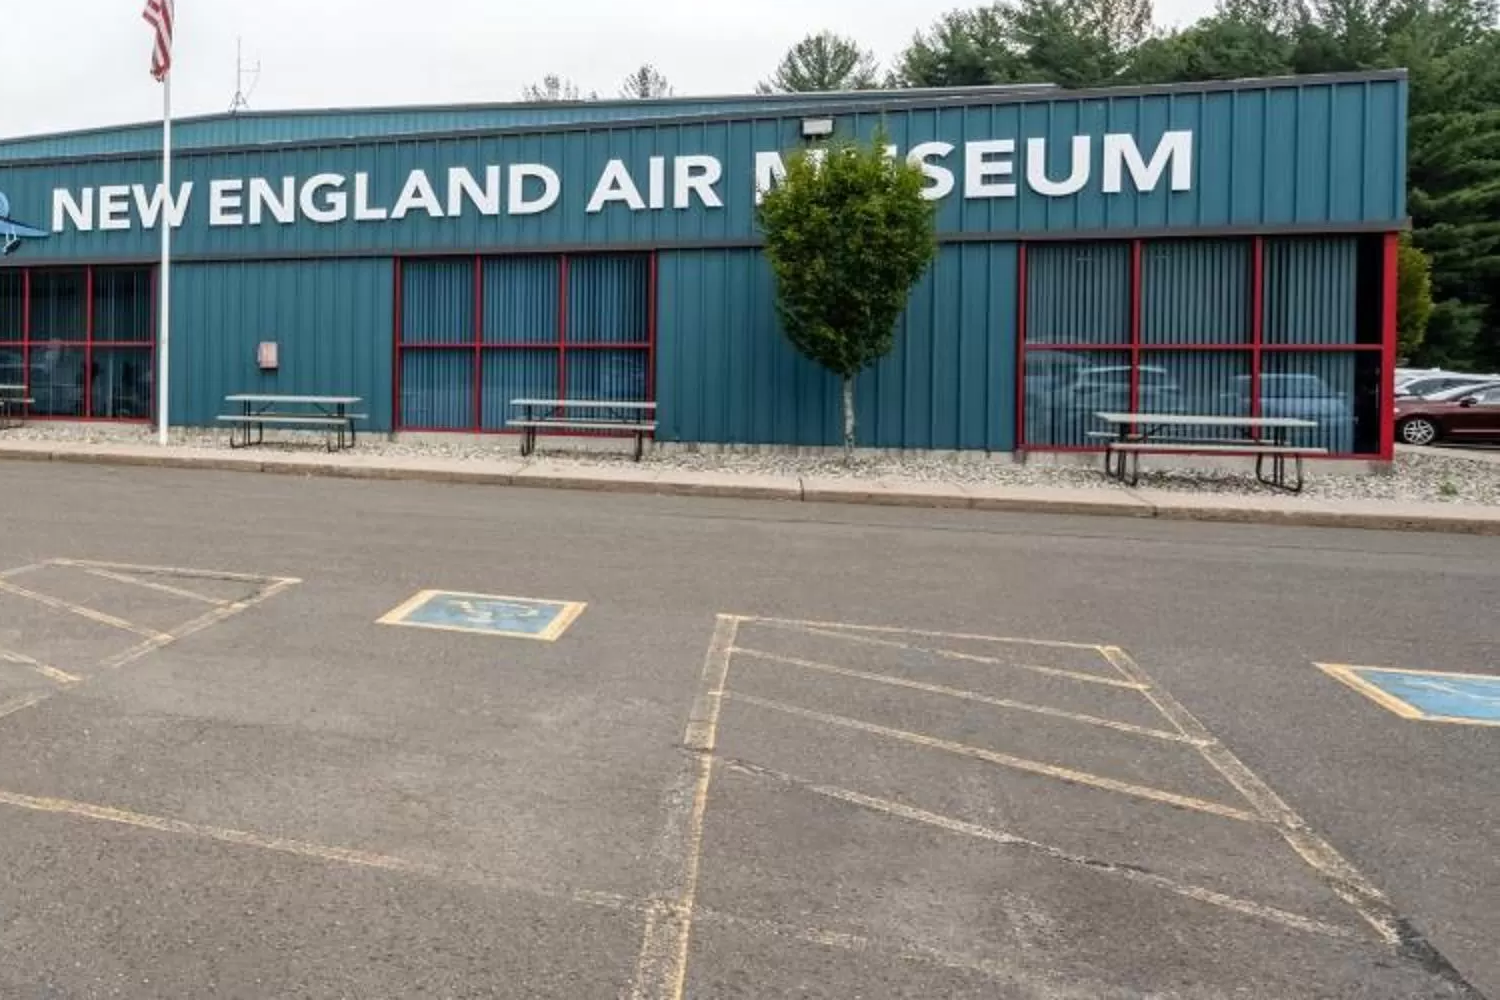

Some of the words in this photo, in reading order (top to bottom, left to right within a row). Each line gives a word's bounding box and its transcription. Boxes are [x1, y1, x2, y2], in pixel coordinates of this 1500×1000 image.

[52, 181, 194, 233] NEW
[209, 163, 561, 226] ENGLAND
[586, 155, 724, 213] AIR
[755, 130, 1193, 205] SEUM
